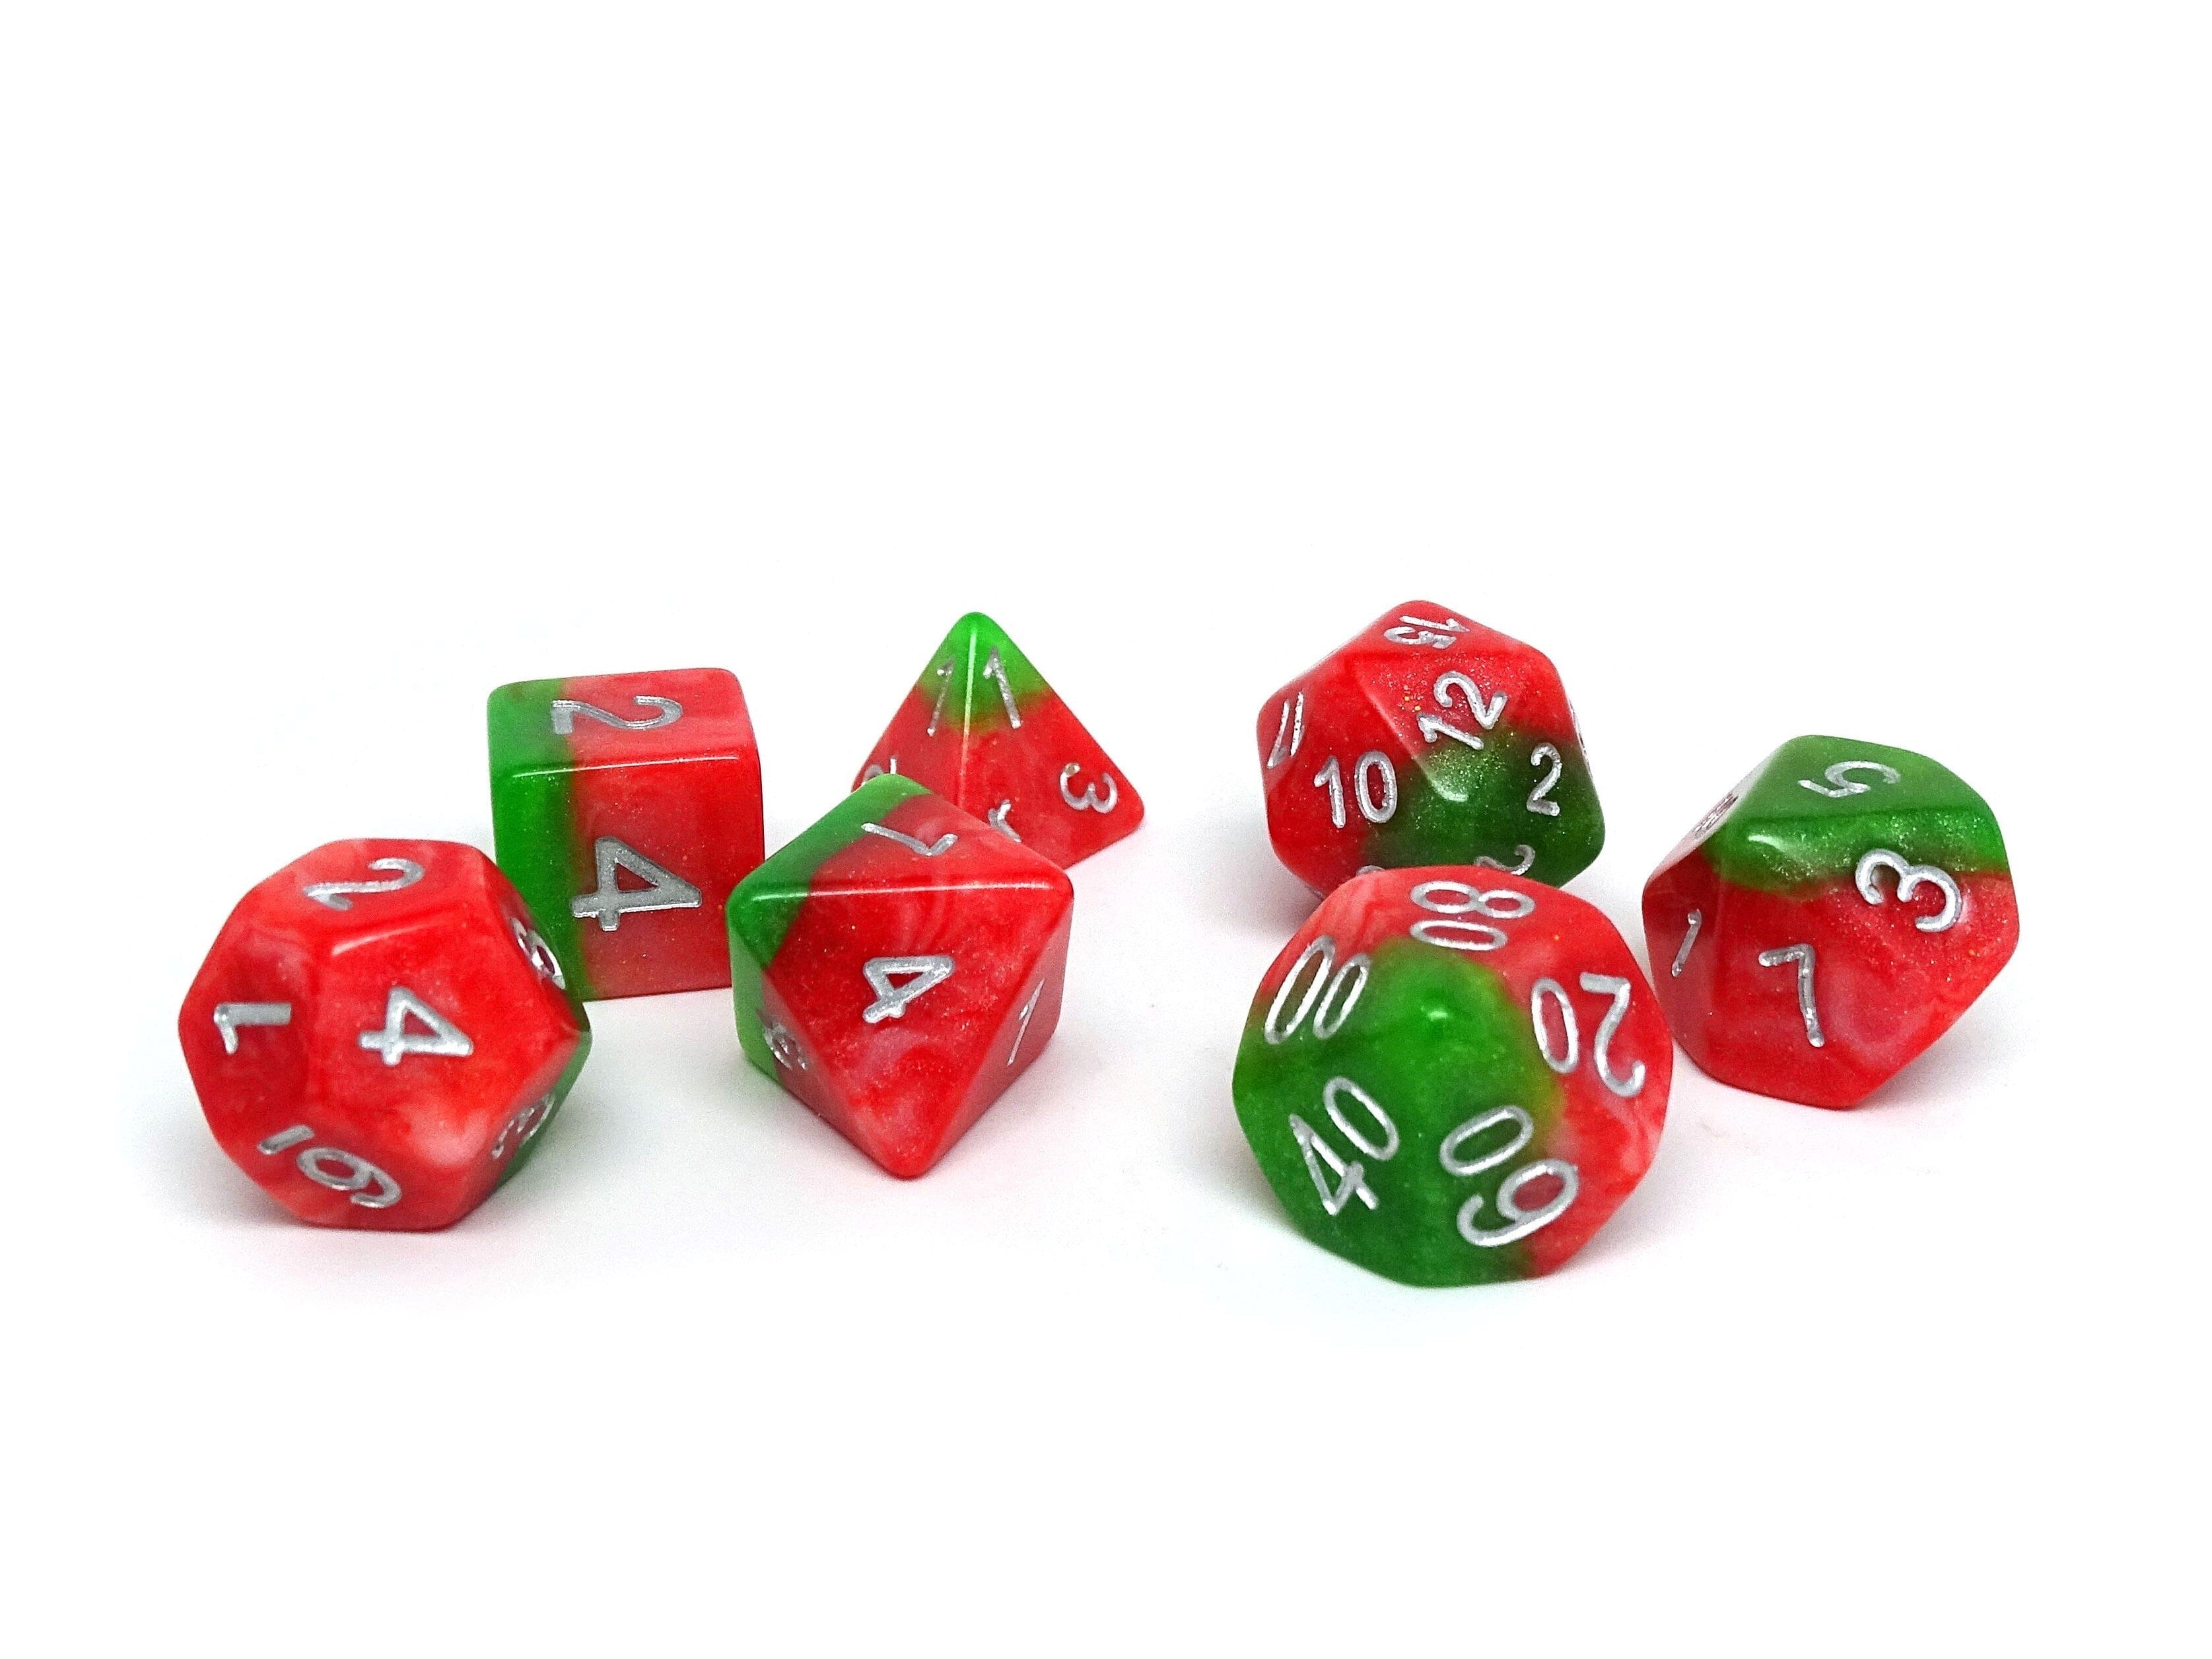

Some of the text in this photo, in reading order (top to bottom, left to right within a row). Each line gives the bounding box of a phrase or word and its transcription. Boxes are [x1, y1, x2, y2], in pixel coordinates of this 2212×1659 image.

[1383, 616, 1470, 649] 15
[551, 695, 683, 735] 2
[926, 658, 955, 737] 1
[983, 645, 1022, 729] 1
[1416, 671, 1508, 750] 12
[1059, 761, 1119, 814] 3
[1313, 750, 1398, 829] 10
[1527, 742, 1562, 817] 2
[1797, 760, 1901, 798] 5
[303, 857, 425, 910] 2
[569, 836, 702, 932] 4
[1409, 880, 1536, 951] 80
[1855, 847, 1964, 933] 3
[1671, 909, 1702, 977] 1
[213, 1002, 292, 1054] 1
[358, 987, 473, 1065] 4
[863, 955, 955, 1024] 4
[1007, 979, 1045, 1066] 1
[1264, 935, 1371, 1044] 00
[1758, 942, 1825, 1048] 7
[1531, 971, 1646, 1098] 20
[1289, 1076, 1400, 1216] 40
